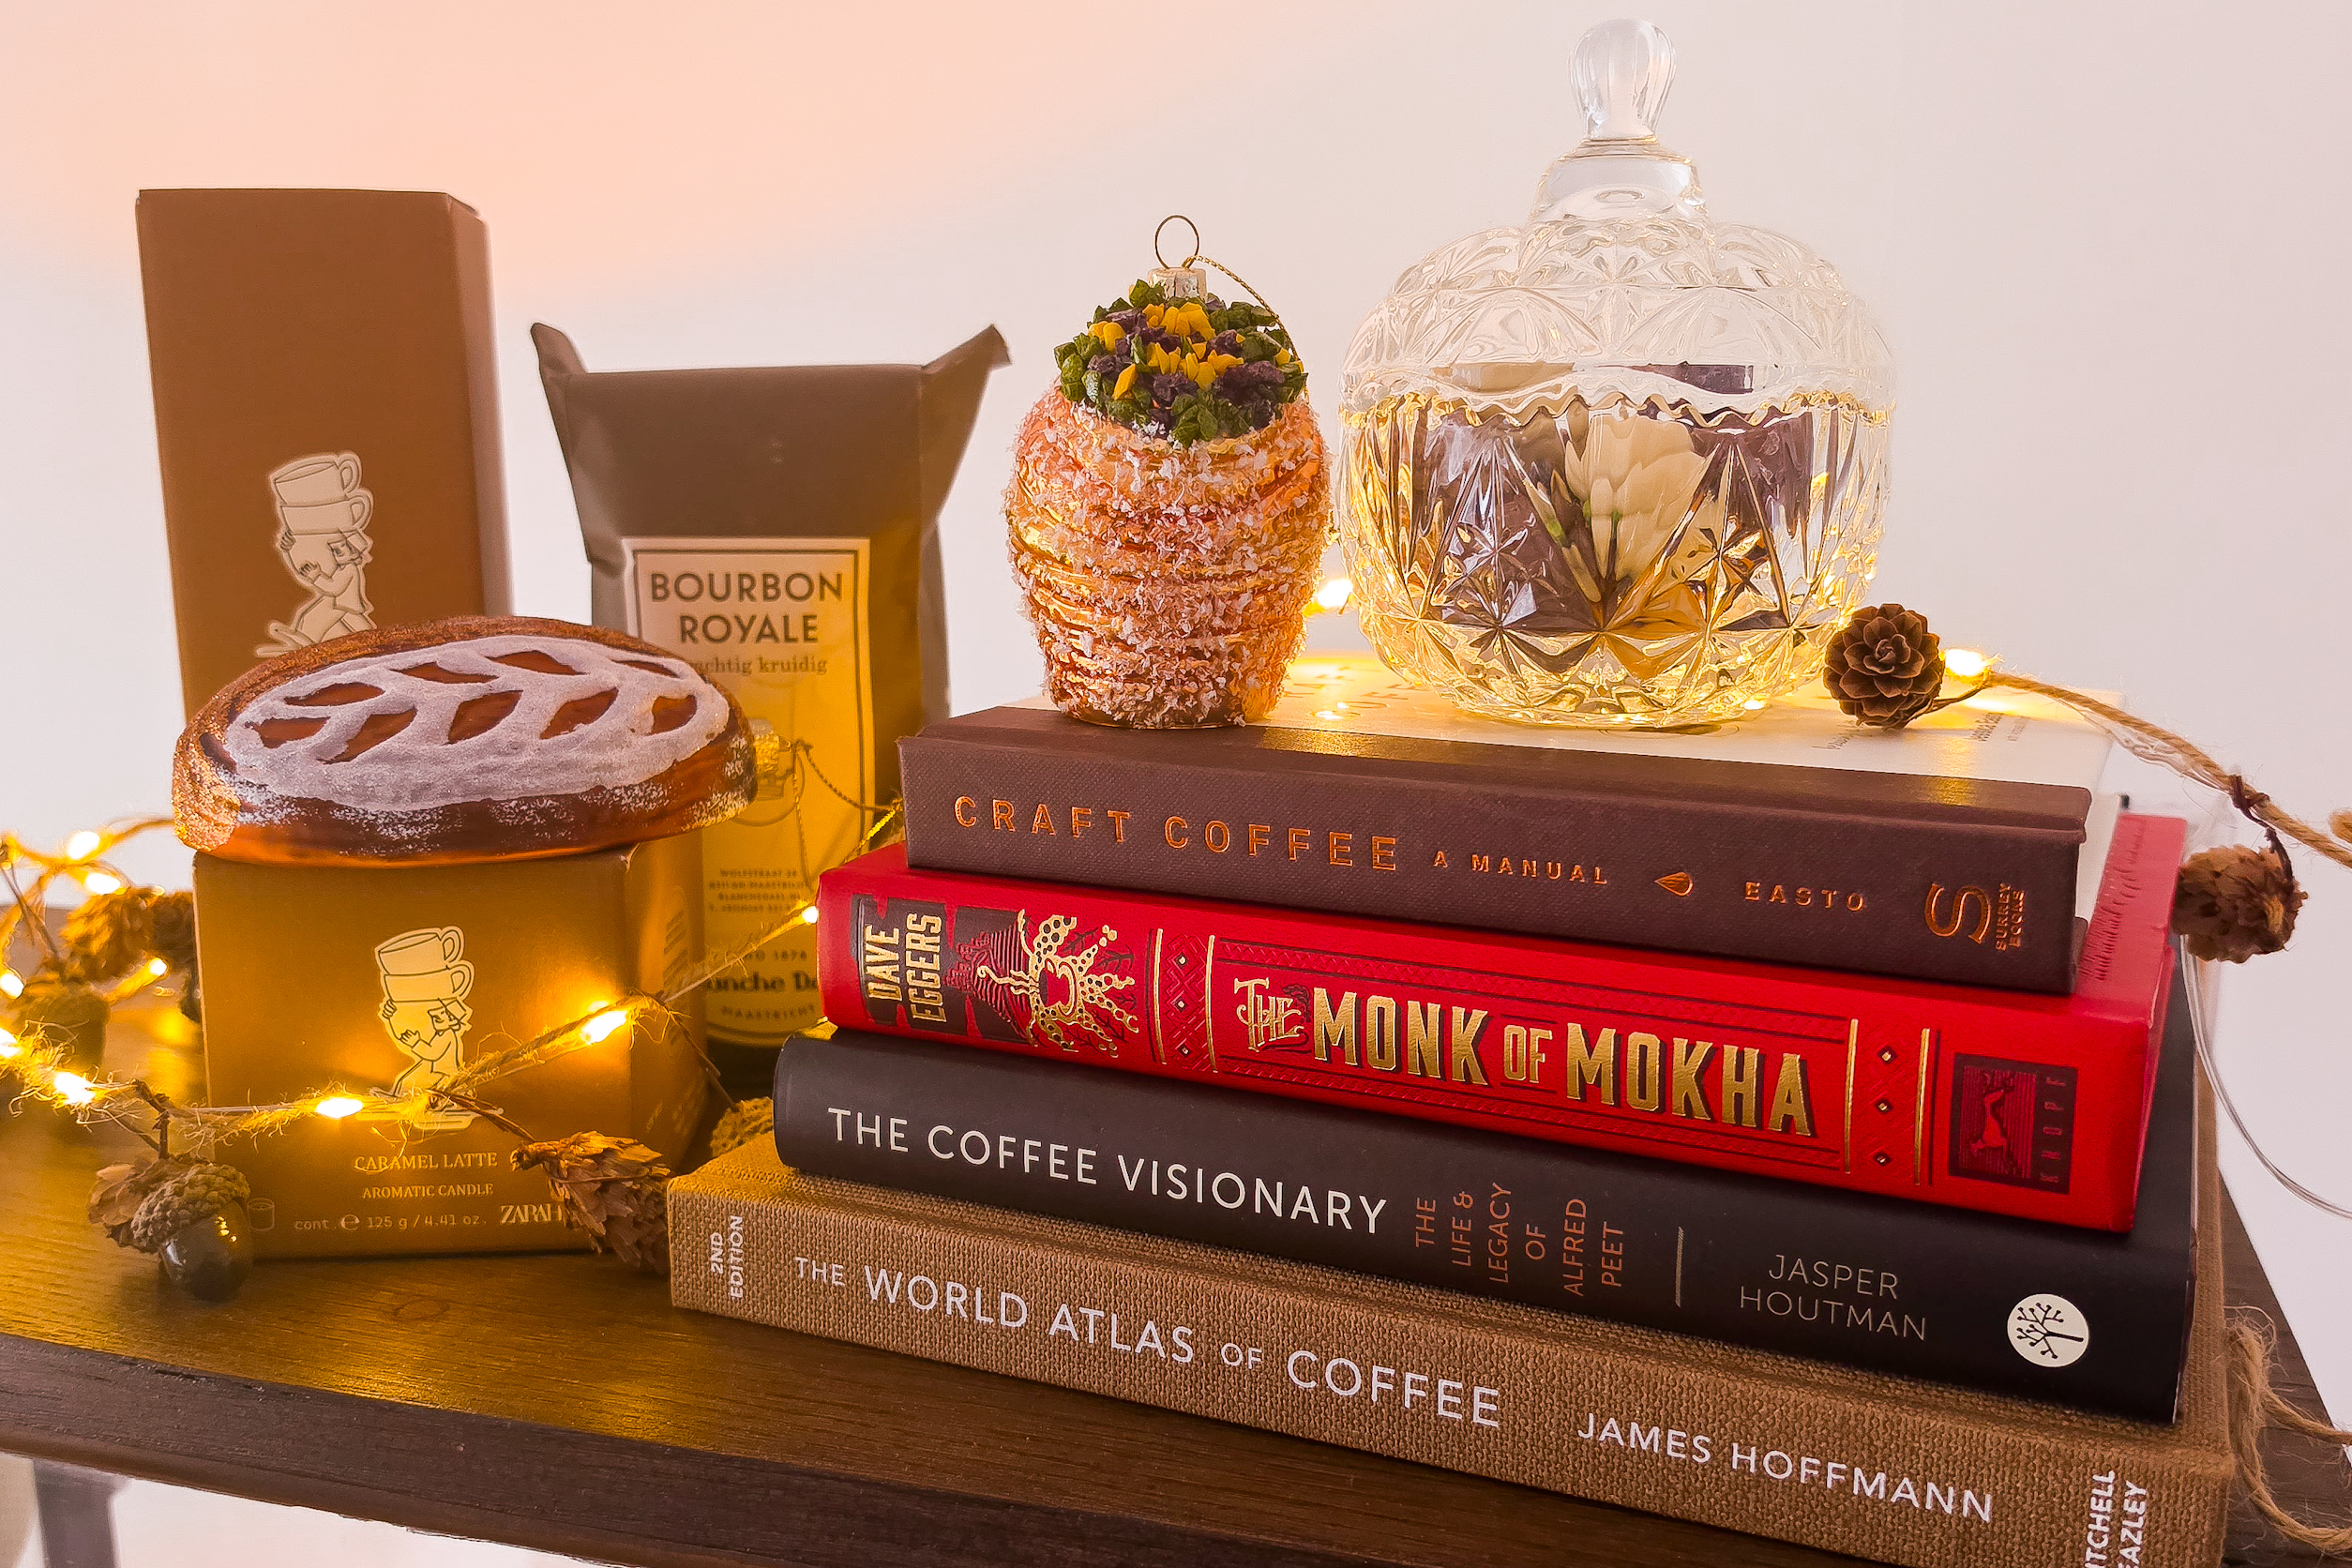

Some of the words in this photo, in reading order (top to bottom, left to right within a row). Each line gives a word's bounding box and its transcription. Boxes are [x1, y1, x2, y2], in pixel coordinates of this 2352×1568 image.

[651, 572, 843, 603] BOURBON
[680, 614, 819, 644] ROYALE
[756, 655, 828, 675] kruidig
[954, 796, 1131, 843] CRAFT
[1164, 815, 1397, 871] COFFEE
[1433, 850, 1449, 867] A
[1471, 853, 1609, 886] MANUAL
[1745, 881, 1865, 912] EASTO
[864, 924, 904, 1003] DAVE
[905, 912, 947, 1024] EGGERS
[1312, 987, 1489, 1086] MONK
[1502, 1024, 1554, 1085] OF
[1566, 1022, 1814, 1137] MOKHA
[354, 1153, 439, 1171] CARAMEL
[444, 1152, 498, 1169] LATTE
[828, 1107, 909, 1153] THE
[927, 1124, 1098, 1185] COFFEE
[1117, 1154, 1388, 1235] VISIONARY
[362, 1184, 435, 1199] AROMATIC
[438, 1183, 494, 1198] CANDLE
[1453, 1190, 1474, 1210] &
[368, 1215, 393, 1229] 125
[399, 1218, 408, 1231] g
[1415, 1197, 1437, 1248] THE
[1451, 1216, 1472, 1267] LIFE
[1487, 1182, 1512, 1283] LEGACY
[1525, 1223, 1546, 1260] OF
[1562, 1199, 1587, 1297] ALFRED
[709, 1231, 725, 1274] 2ND
[730, 1215, 744, 1300] EDITION
[1601, 1221, 1624, 1288] PEET
[1768, 1254, 1899, 1300] JASPER
[1739, 1285, 1926, 1342] HOUTMAN
[794, 1257, 846, 1288] THE
[864, 1264, 1028, 1329] WORLD
[1048, 1303, 1195, 1364] ATLAS
[1220, 1342, 1263, 1370] OF
[1287, 1349, 1500, 1428] COFFEE
[1577, 1412, 1711, 1465] JAMES
[1730, 1441, 1994, 1524] HOFFMANN
